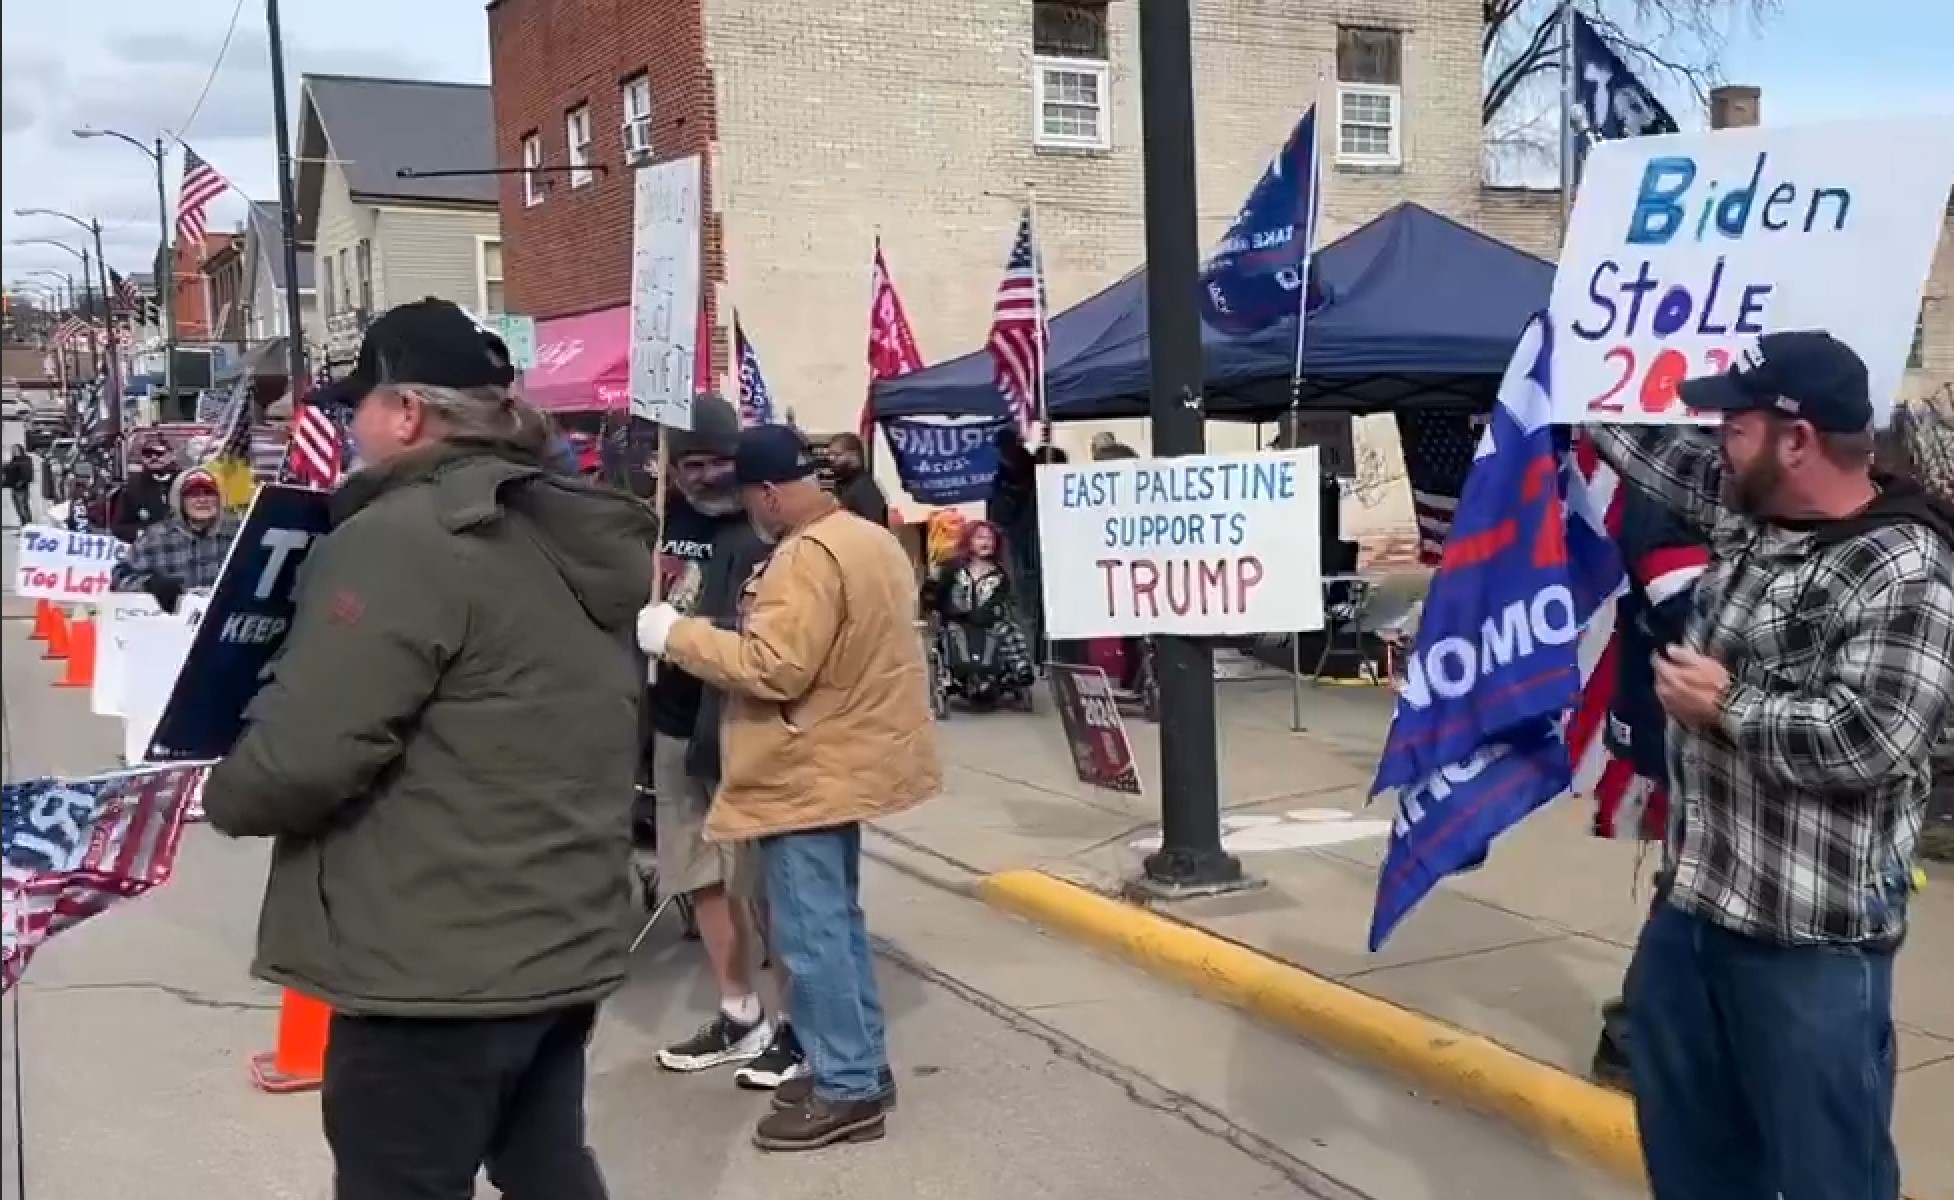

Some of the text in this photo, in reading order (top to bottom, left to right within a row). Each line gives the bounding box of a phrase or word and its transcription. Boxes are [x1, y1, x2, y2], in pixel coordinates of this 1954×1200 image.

[1625, 151, 1851, 245] Biden
[1063, 461, 1296, 508] EAST PALESTINE
[1105, 512, 1247, 547] SUPPORTS
[1096, 555, 1264, 618] TRUMP
[220, 612, 287, 643] KEEP
